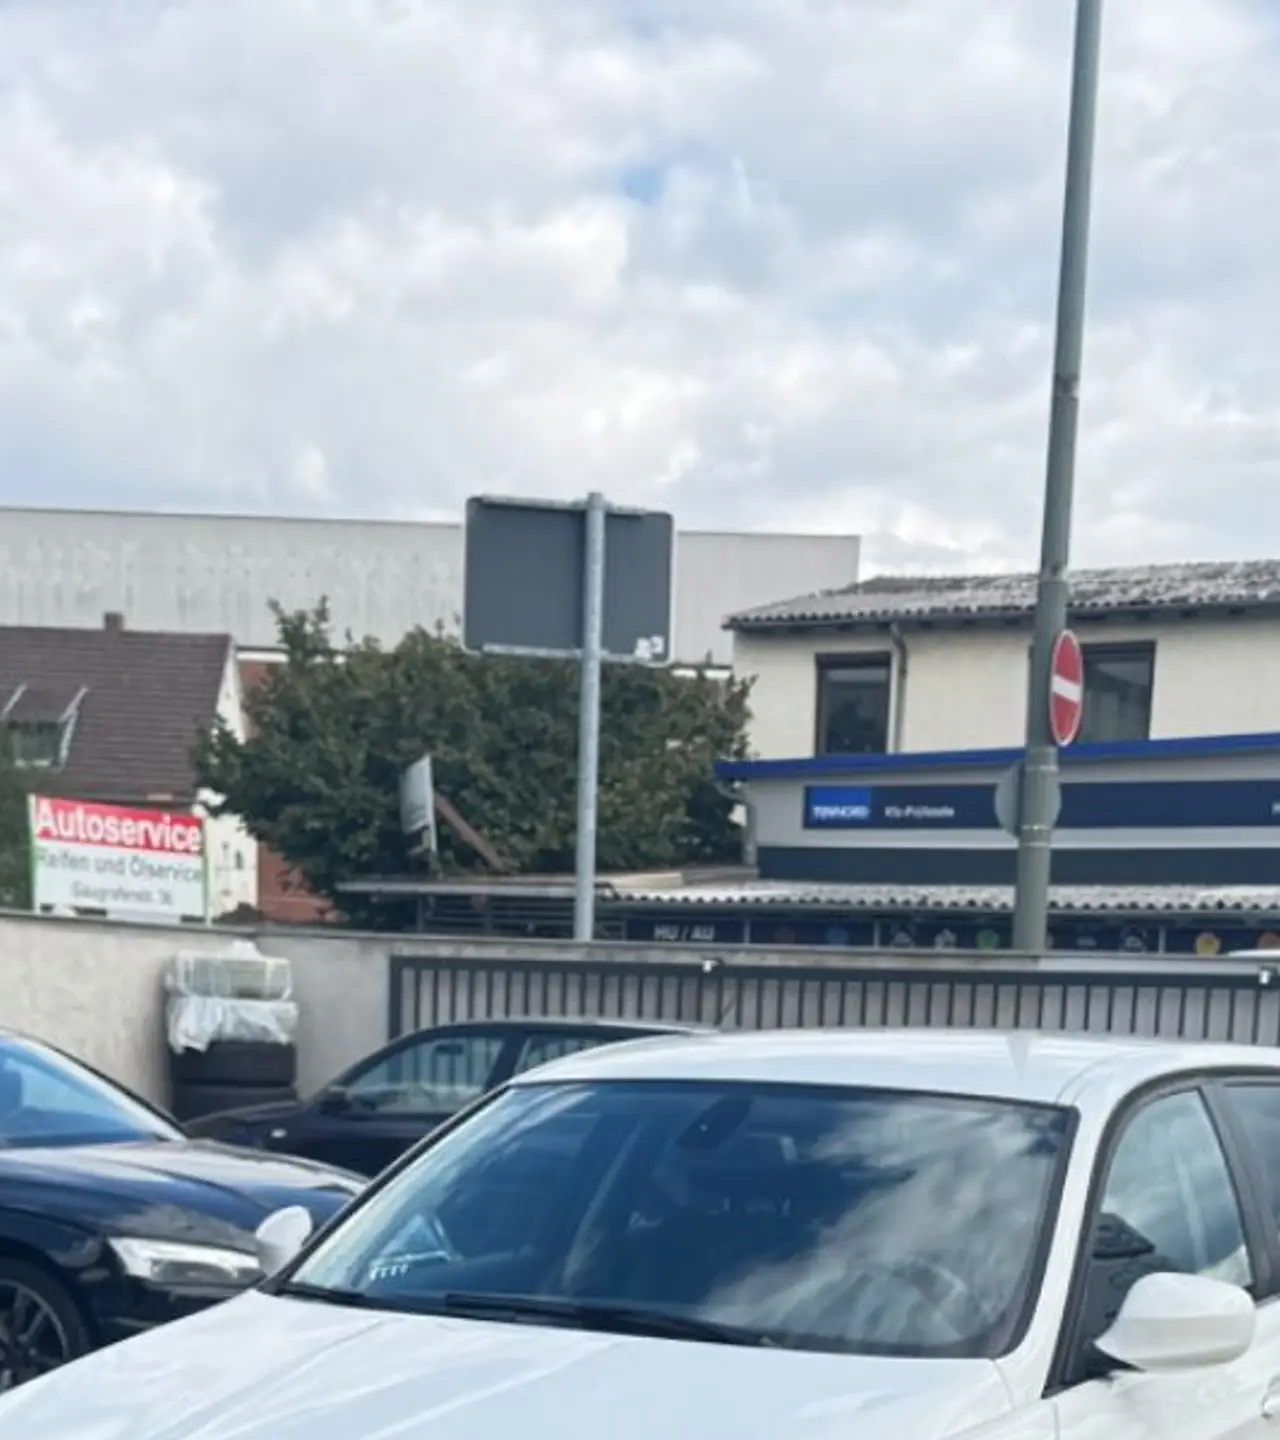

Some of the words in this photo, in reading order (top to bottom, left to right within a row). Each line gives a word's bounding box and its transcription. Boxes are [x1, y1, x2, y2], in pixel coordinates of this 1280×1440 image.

[36, 799, 202, 850] Autoservice
[37, 848, 90, 870] Reifen
[95, 856, 125, 877] und
[129, 855, 203, 882] Ölservice
